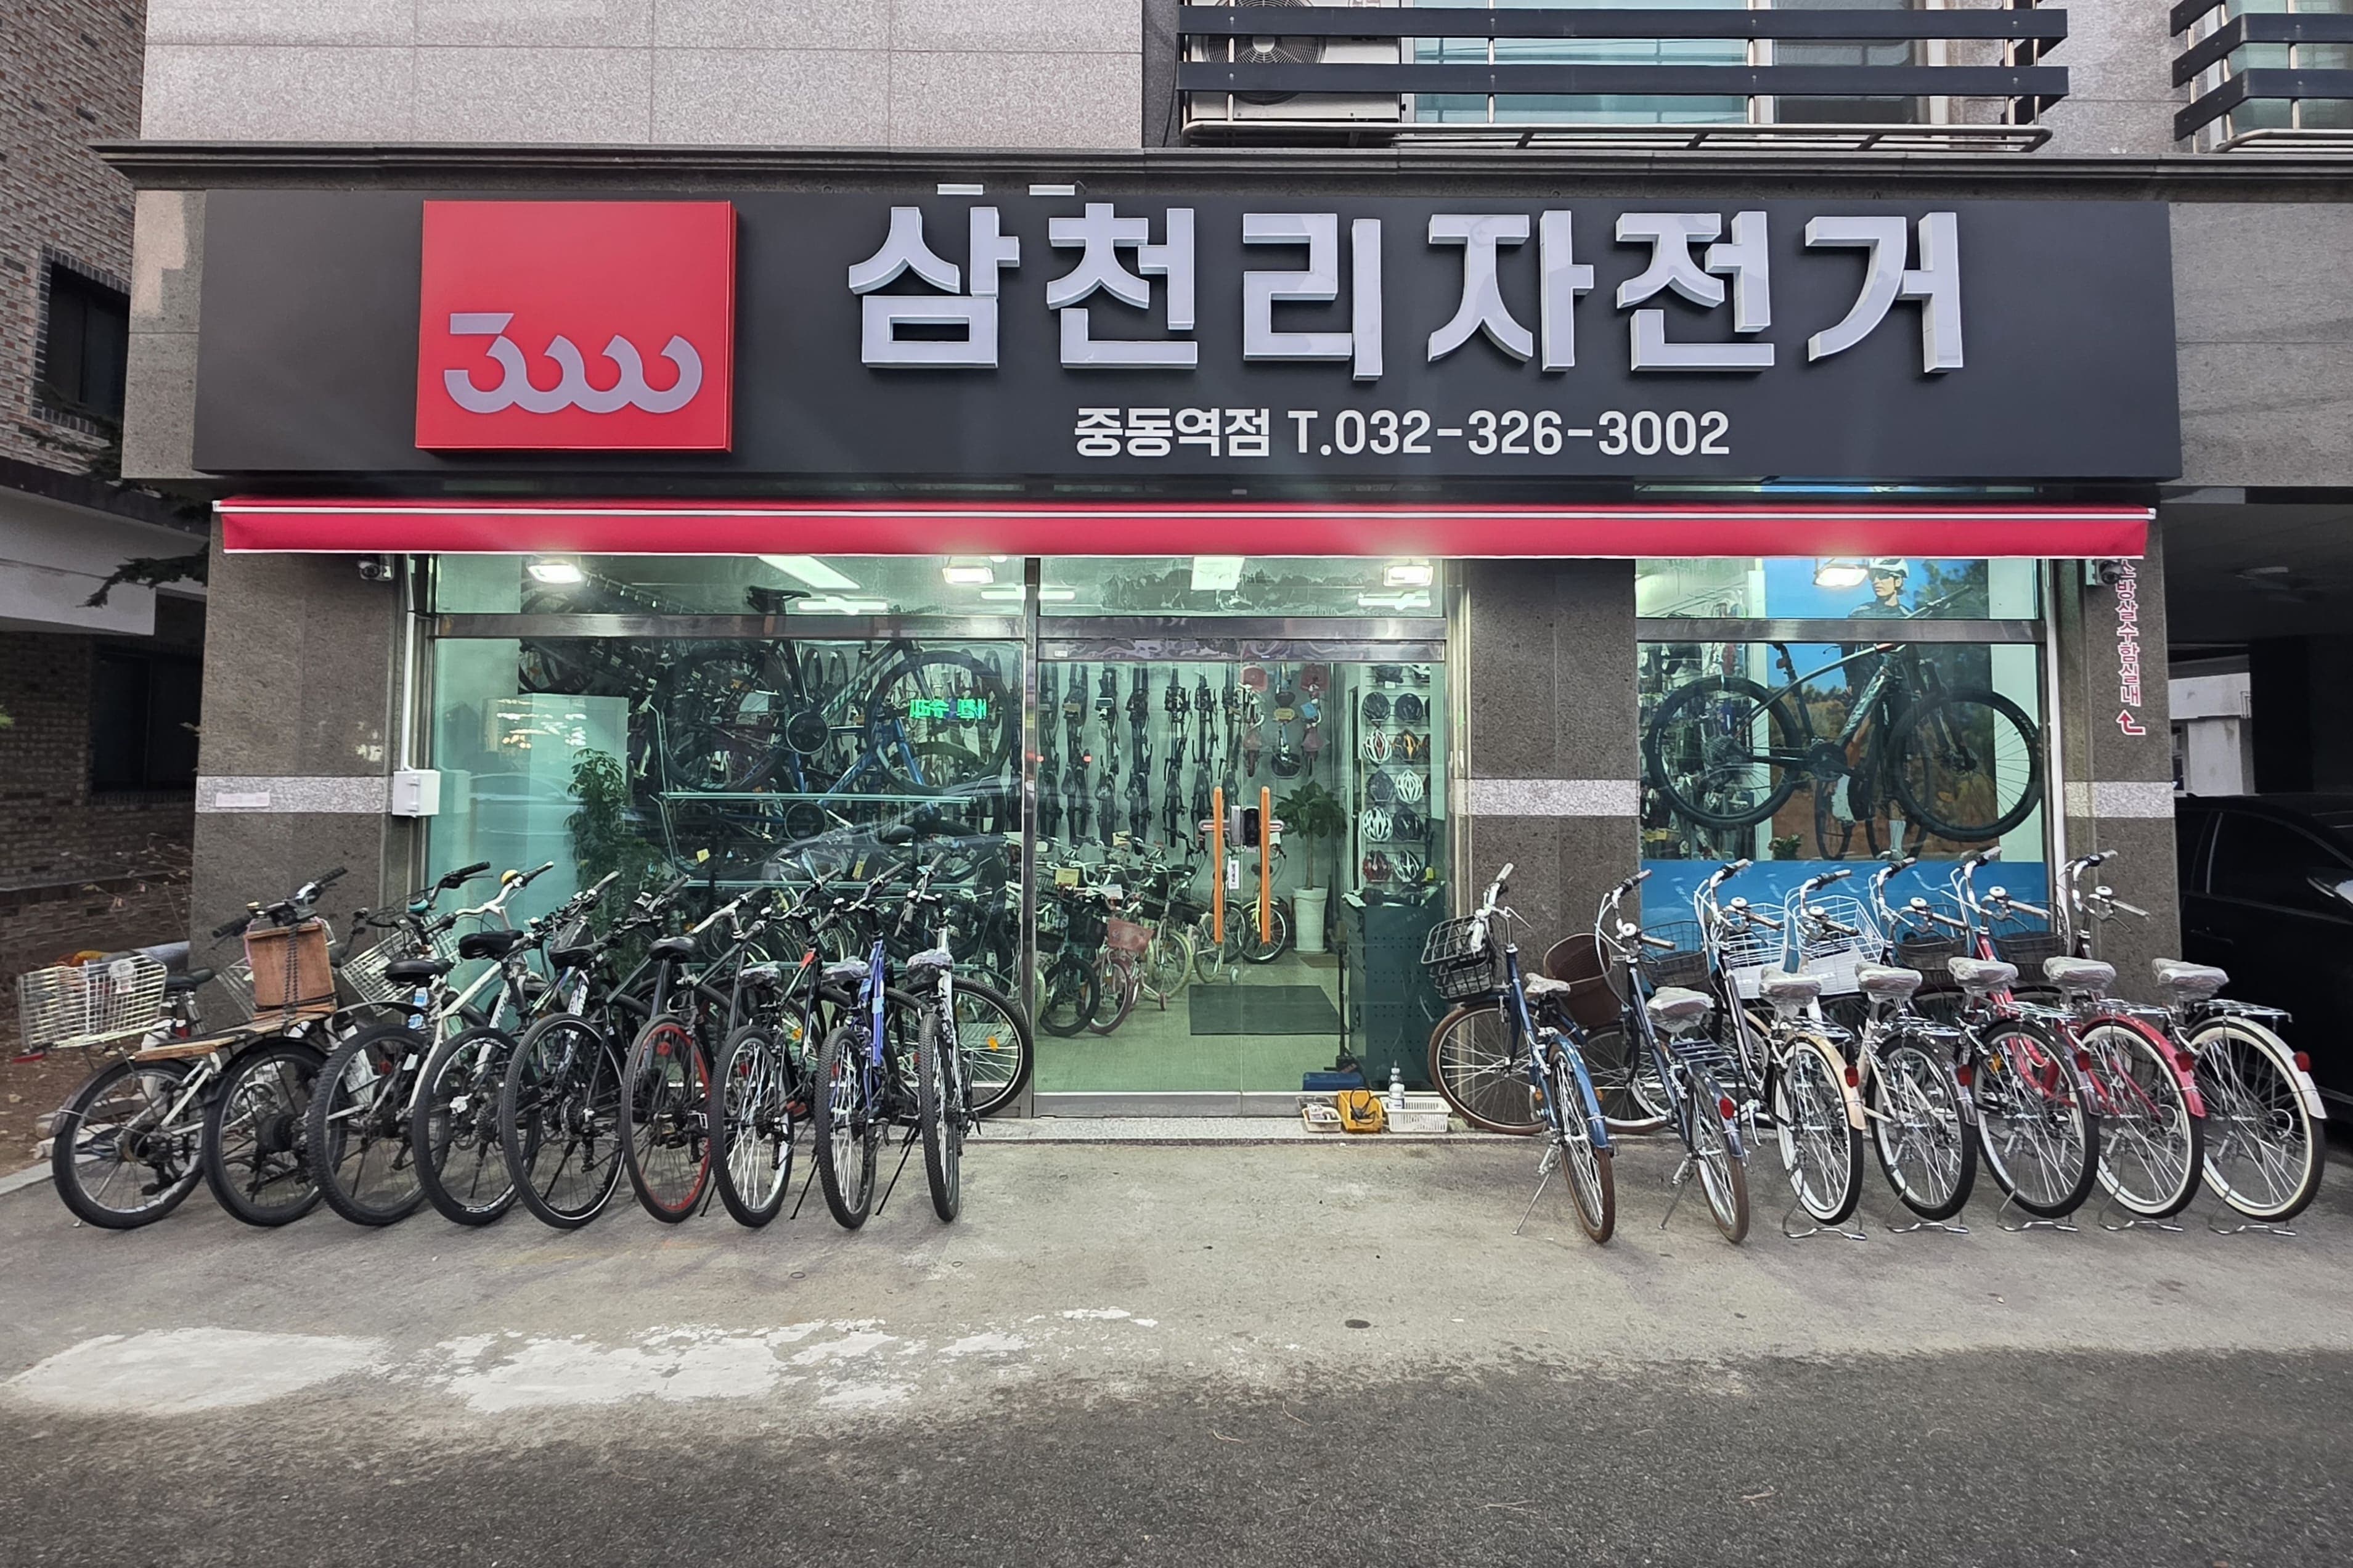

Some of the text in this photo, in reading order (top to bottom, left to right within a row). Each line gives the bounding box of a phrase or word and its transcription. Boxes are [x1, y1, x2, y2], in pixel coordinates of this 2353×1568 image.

[849, 203, 1963, 380] 삼천리자전거
[1074, 408, 1729, 457] 중동역점 T.032-326-3002
